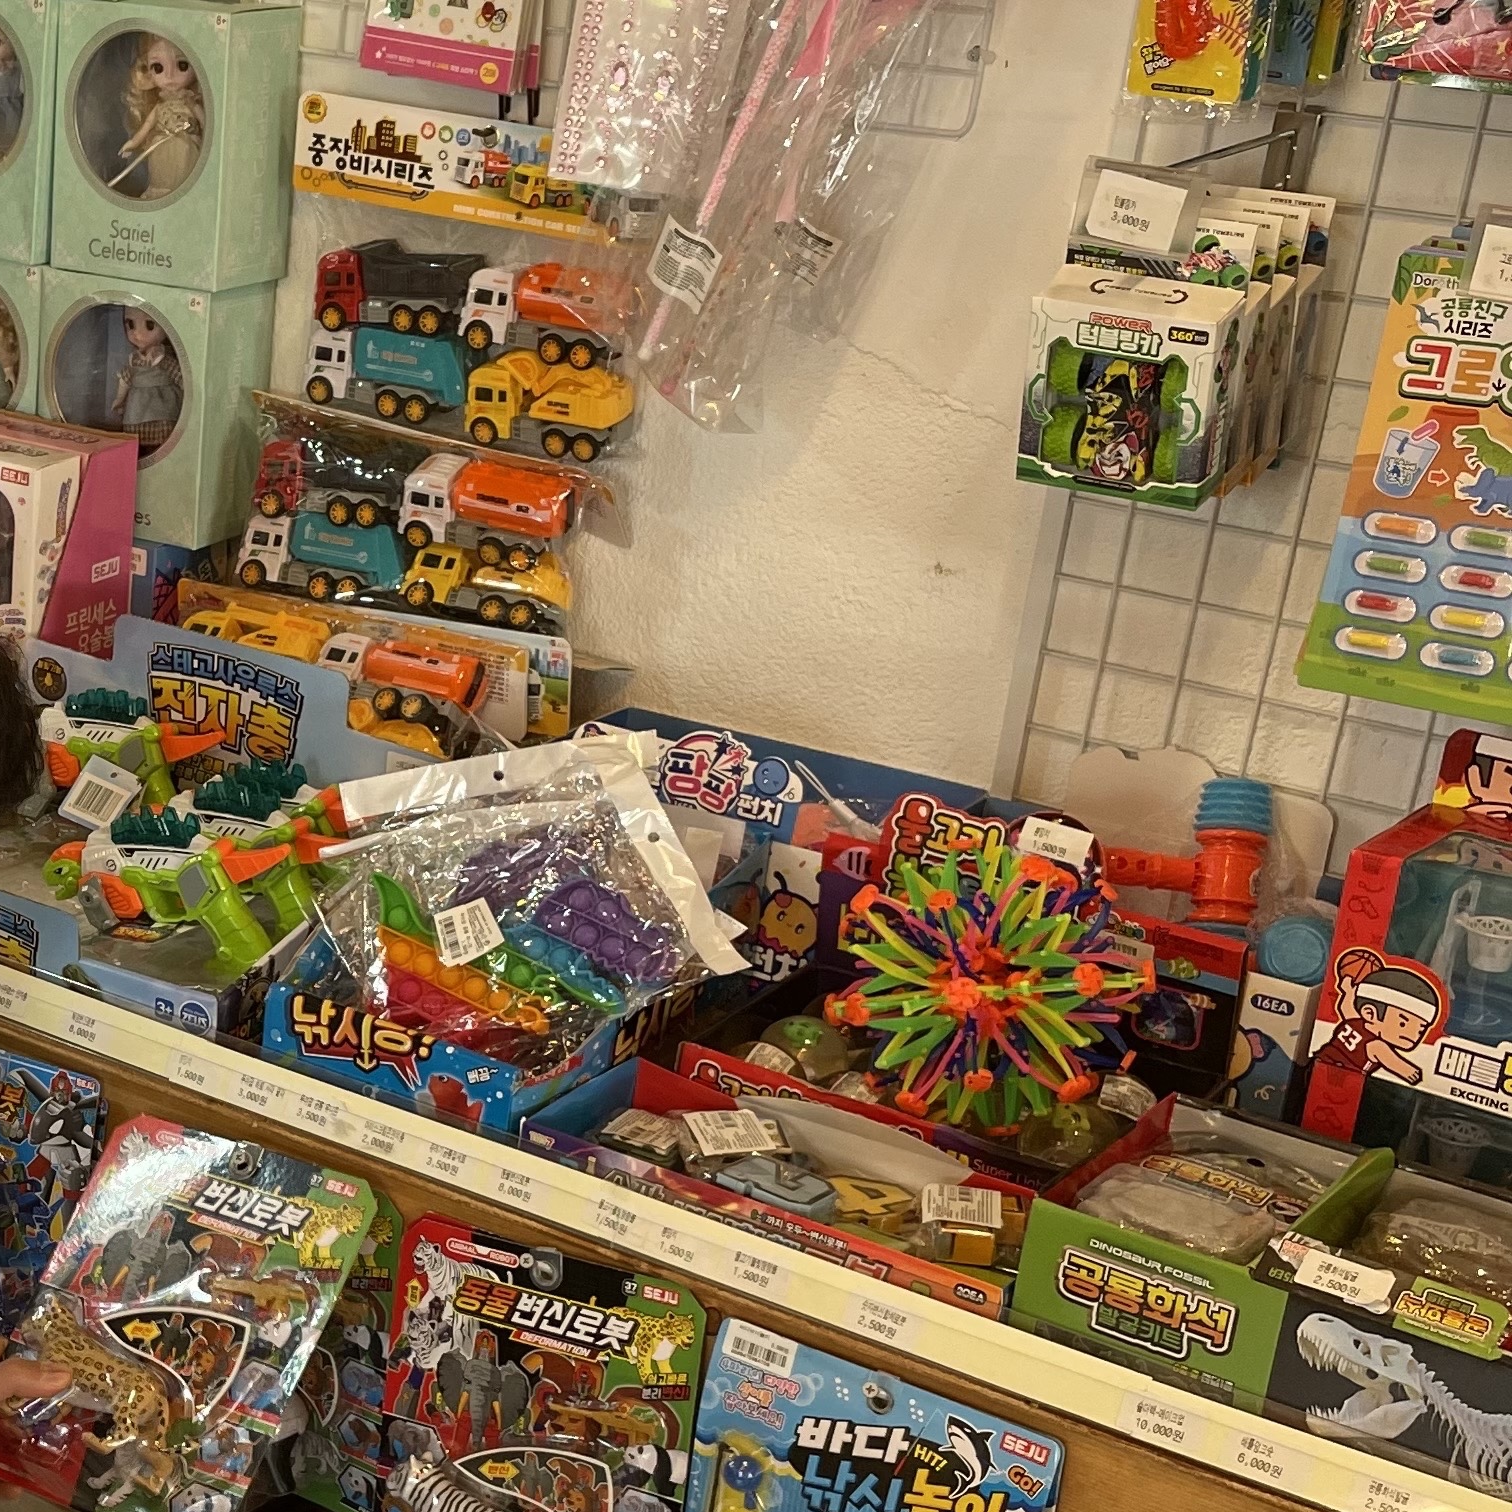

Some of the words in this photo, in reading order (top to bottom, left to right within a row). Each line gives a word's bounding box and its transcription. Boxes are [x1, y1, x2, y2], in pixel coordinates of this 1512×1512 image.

[307, 132, 435, 190] 중장비시리즈
[109, 219, 156, 246] Sariel
[1110, 211, 1152, 232] 3,000원
[88, 238, 173, 269] Celebrities
[1412, 273, 1462, 290] Doroth
[1440, 297, 1509, 322] 공룡친구
[1090, 313, 1153, 334] POWER
[1443, 318, 1494, 339] 시리즈
[1077, 323, 1162, 357] 텀블링카
[0, 467, 31, 487] SEJU
[92, 560, 120, 581] SEJU
[64, 599, 118, 637] 프린세스
[151, 646, 300, 710] 스테고사우루스
[150, 676, 294, 762] 전자총
[737, 794, 783, 827] 펀치
[155, 1001, 174, 1016] 3+
[1255, 995, 1289, 1015] 16EA
[1337, 1023, 1364, 1052] 23
[1449, 1086, 1510, 1113] EXCITING
[425, 1156, 459, 1177] 3,500원
[497, 1182, 532, 1202] 8,000원
[178, 1176, 313, 1238] 변신로봇
[448, 1239, 479, 1256] ANIMAL
[489, 1250, 518, 1266] ROBOT
[658, 1240, 694, 1263] 1,500원
[1089, 1238, 1164, 1274] DINOSAUR
[1163, 1264, 1216, 1290] FOSSIL
[733, 1265, 770, 1288] 1,500원
[624, 1280, 638, 1293] 37
[642, 1285, 681, 1306] SEJU
[1063, 1255, 1232, 1345] 공룡화석
[454, 1278, 638, 1351] 동물변신로봇
[857, 1315, 898, 1340] 2,500원
[1097, 1304, 1184, 1351] 발굴키트
[518, 1330, 592, 1358] DEFORMATION
[763, 1374, 801, 1400] 다양한
[1135, 1417, 1185, 1443] 10,000원
[795, 1417, 910, 1464] 바다
[913, 1443, 948, 1472] HIT!
[1002, 1434, 1049, 1466] SEJU
[1237, 1452, 1284, 1479] 6,000원
